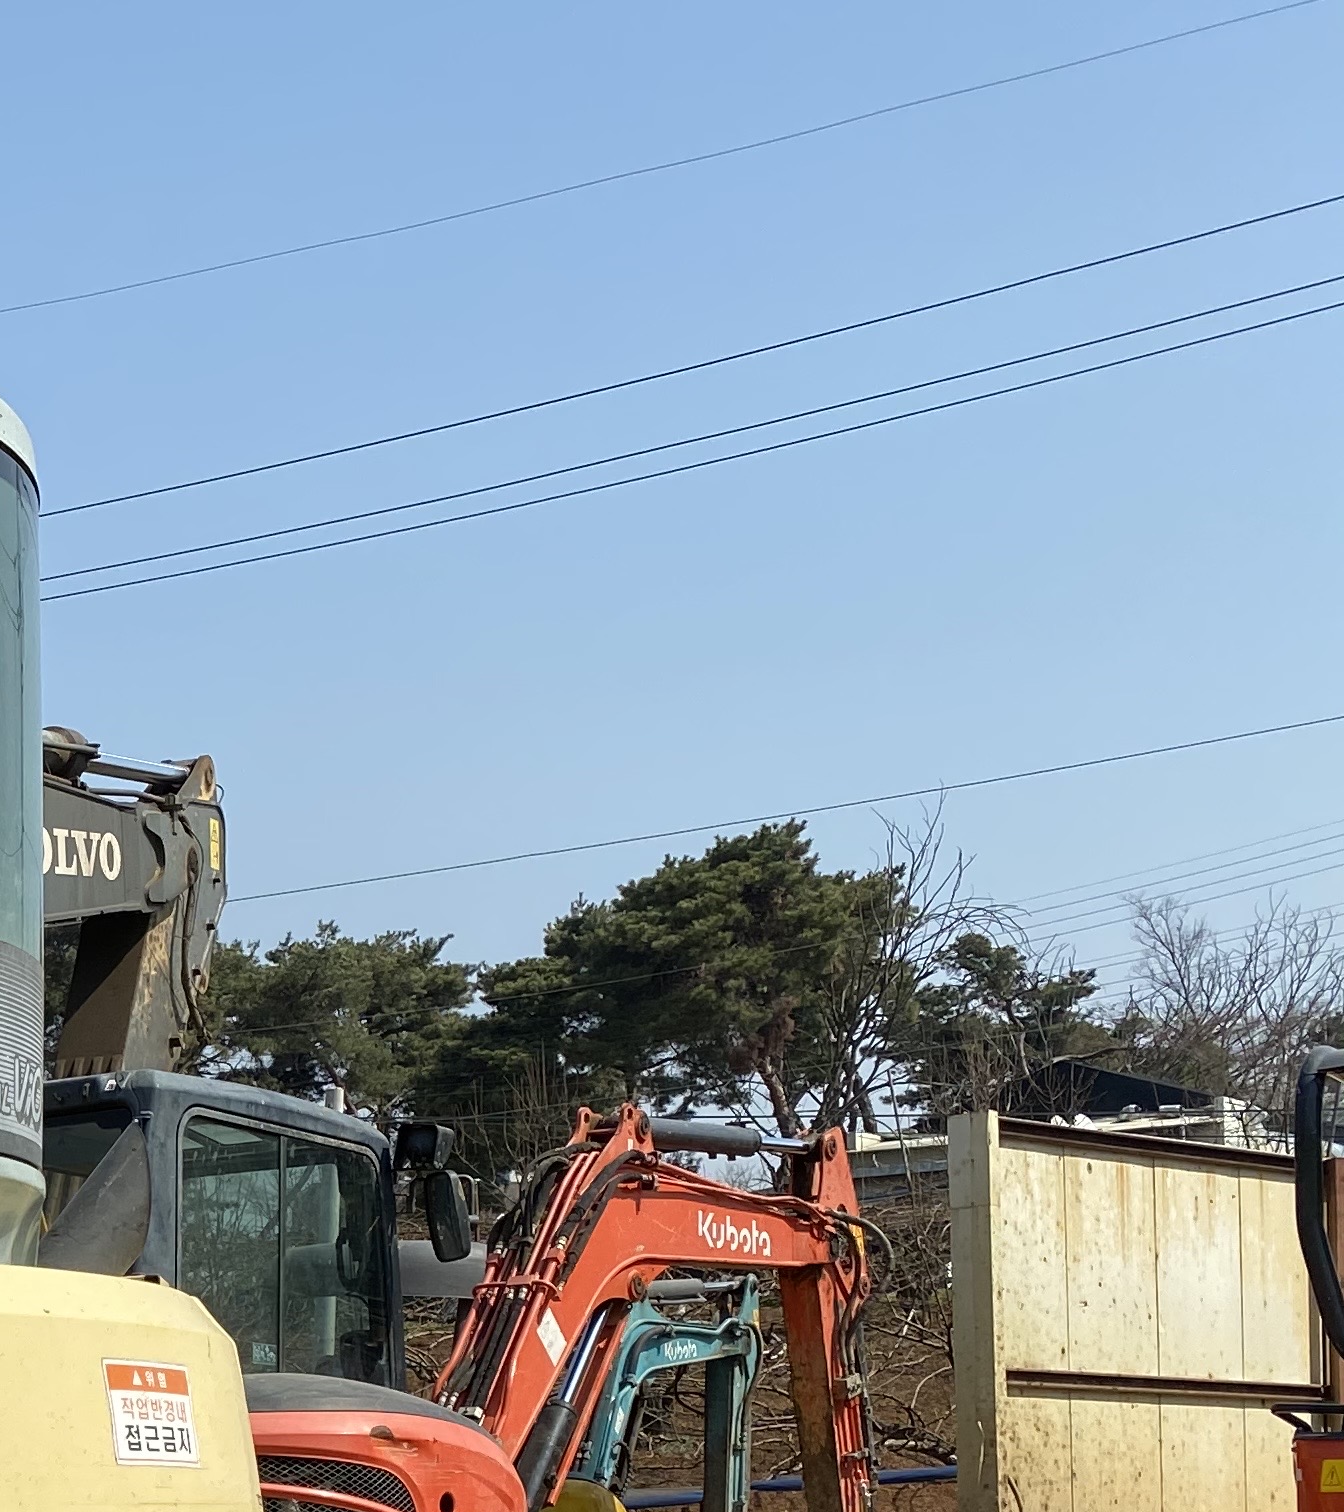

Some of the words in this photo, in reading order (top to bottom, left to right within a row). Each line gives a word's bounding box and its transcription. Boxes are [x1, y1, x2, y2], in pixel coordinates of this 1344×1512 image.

[43, 827, 122, 881] LVO
[697, 1209, 772, 1258] Kubota
[664, 1340, 697, 1361] Kubota
[120, 1397, 188, 1424] 작업반경내
[124, 1424, 192, 1454] 접근금지
